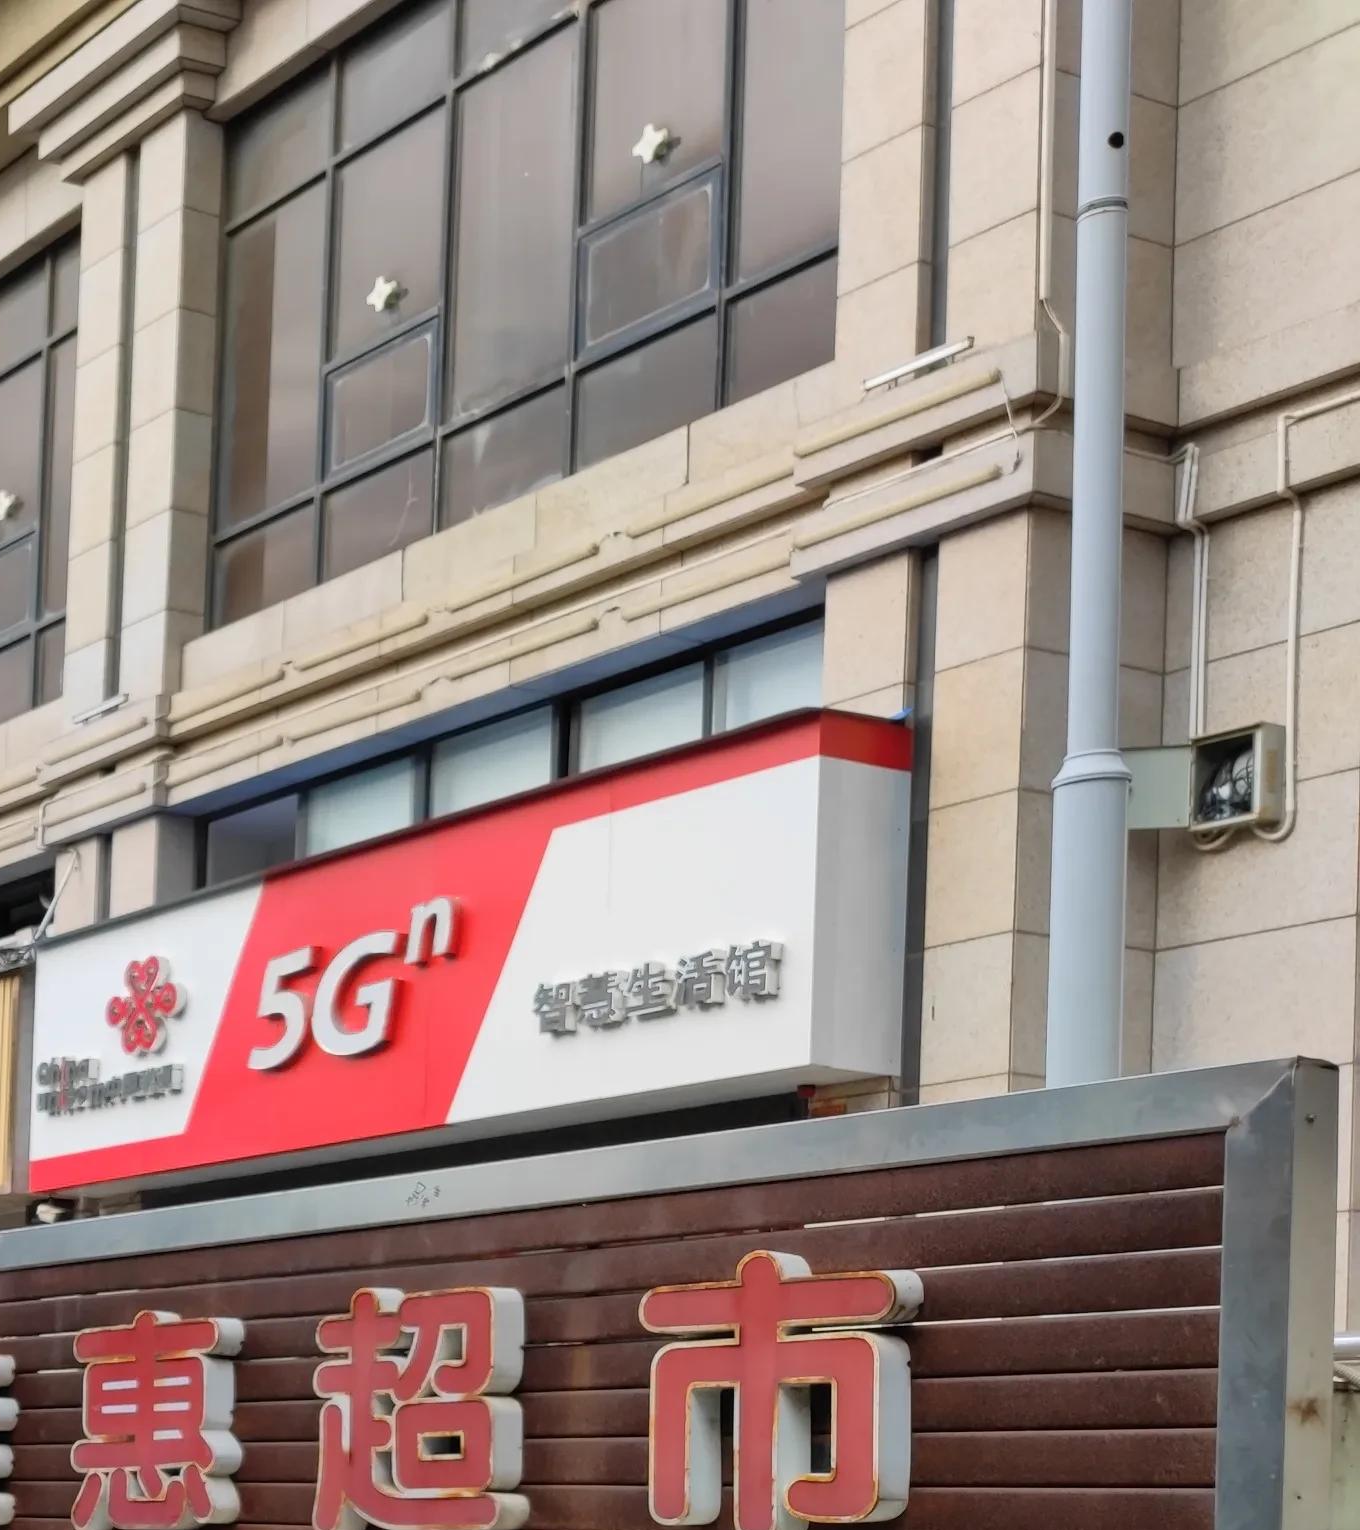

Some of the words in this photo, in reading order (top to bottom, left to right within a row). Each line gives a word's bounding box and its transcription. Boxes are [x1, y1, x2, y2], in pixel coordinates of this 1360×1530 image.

[533, 940, 784, 1037] 智慧生活馆
